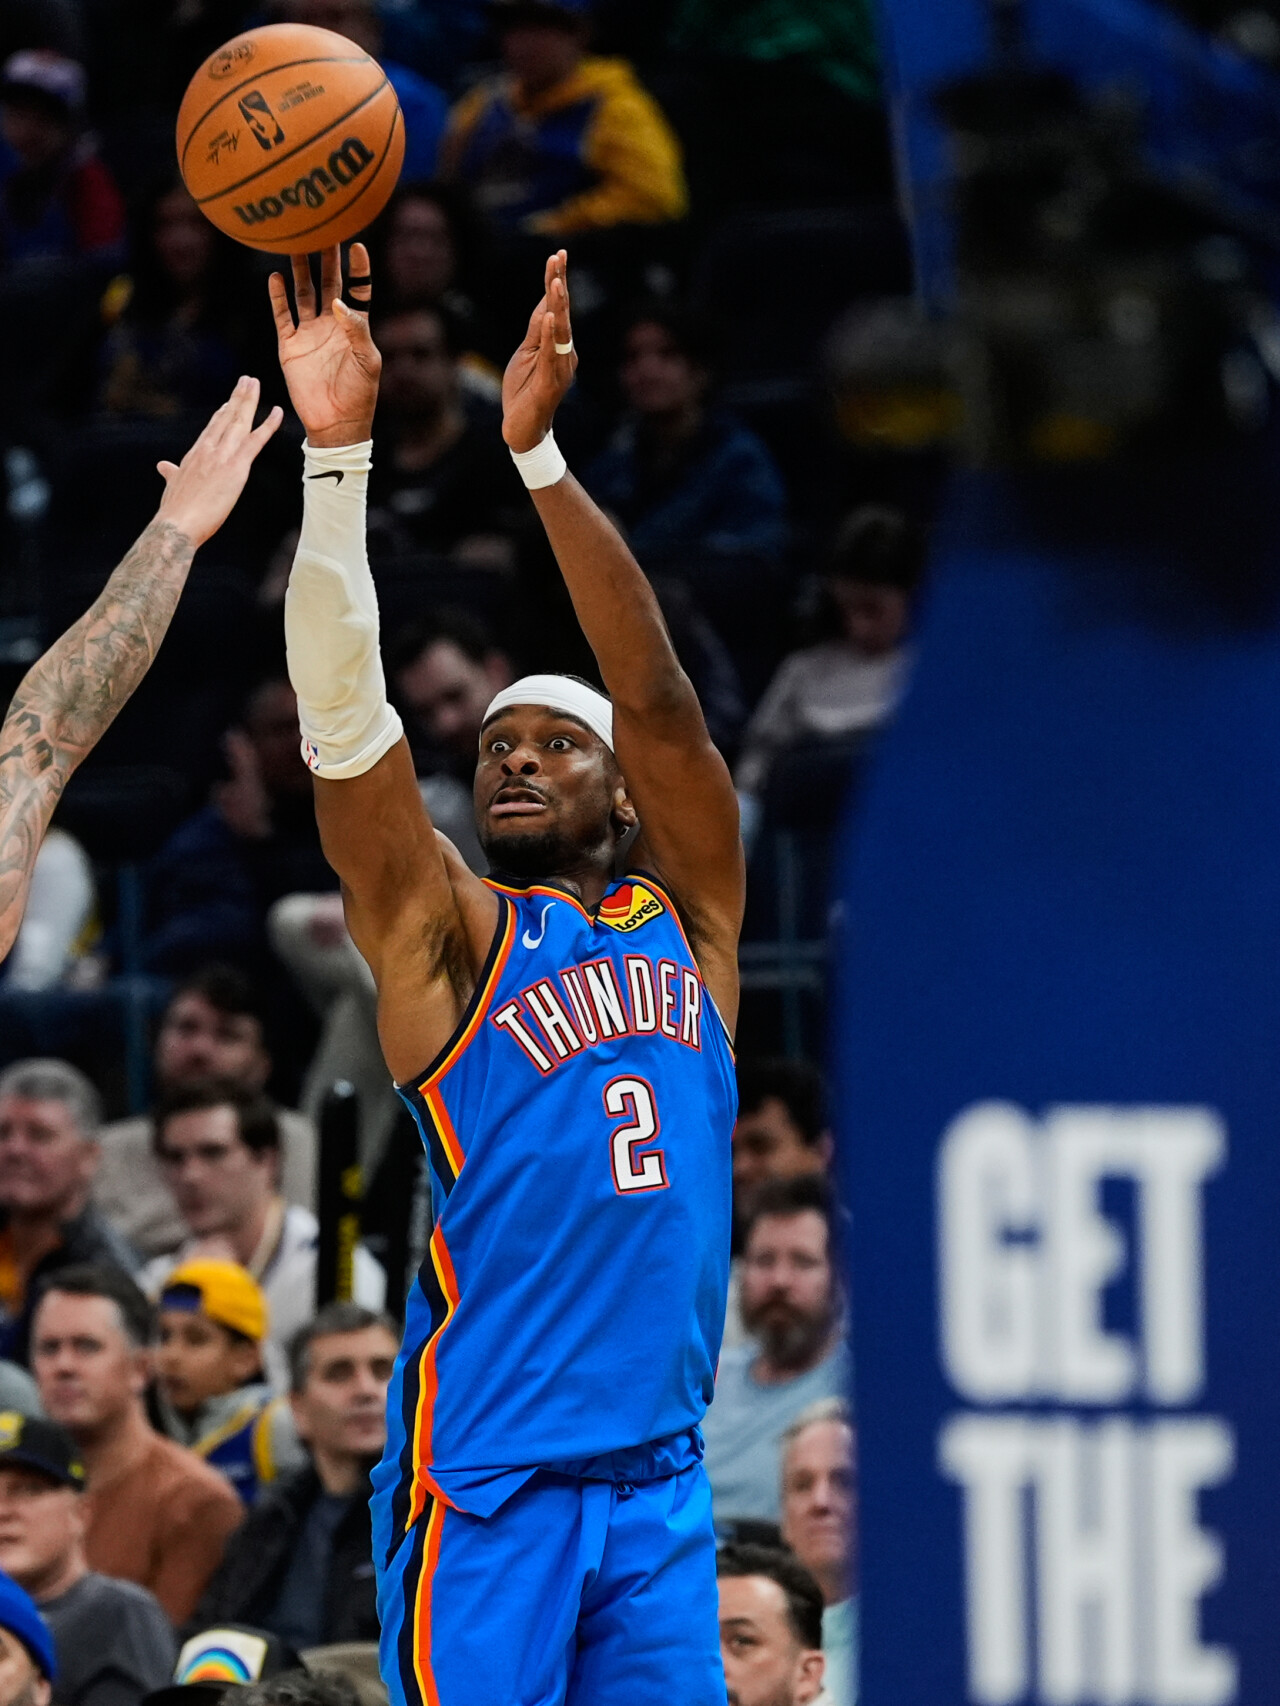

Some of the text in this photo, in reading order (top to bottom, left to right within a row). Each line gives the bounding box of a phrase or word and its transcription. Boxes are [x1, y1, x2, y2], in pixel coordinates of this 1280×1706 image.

[233, 137, 375, 225] Wilson
[490, 954, 702, 1077] THUNDER
[602, 1074, 669, 1195] 2
[937, 1101, 1227, 1404] GET
[939, 1413, 1238, 1706] THE
